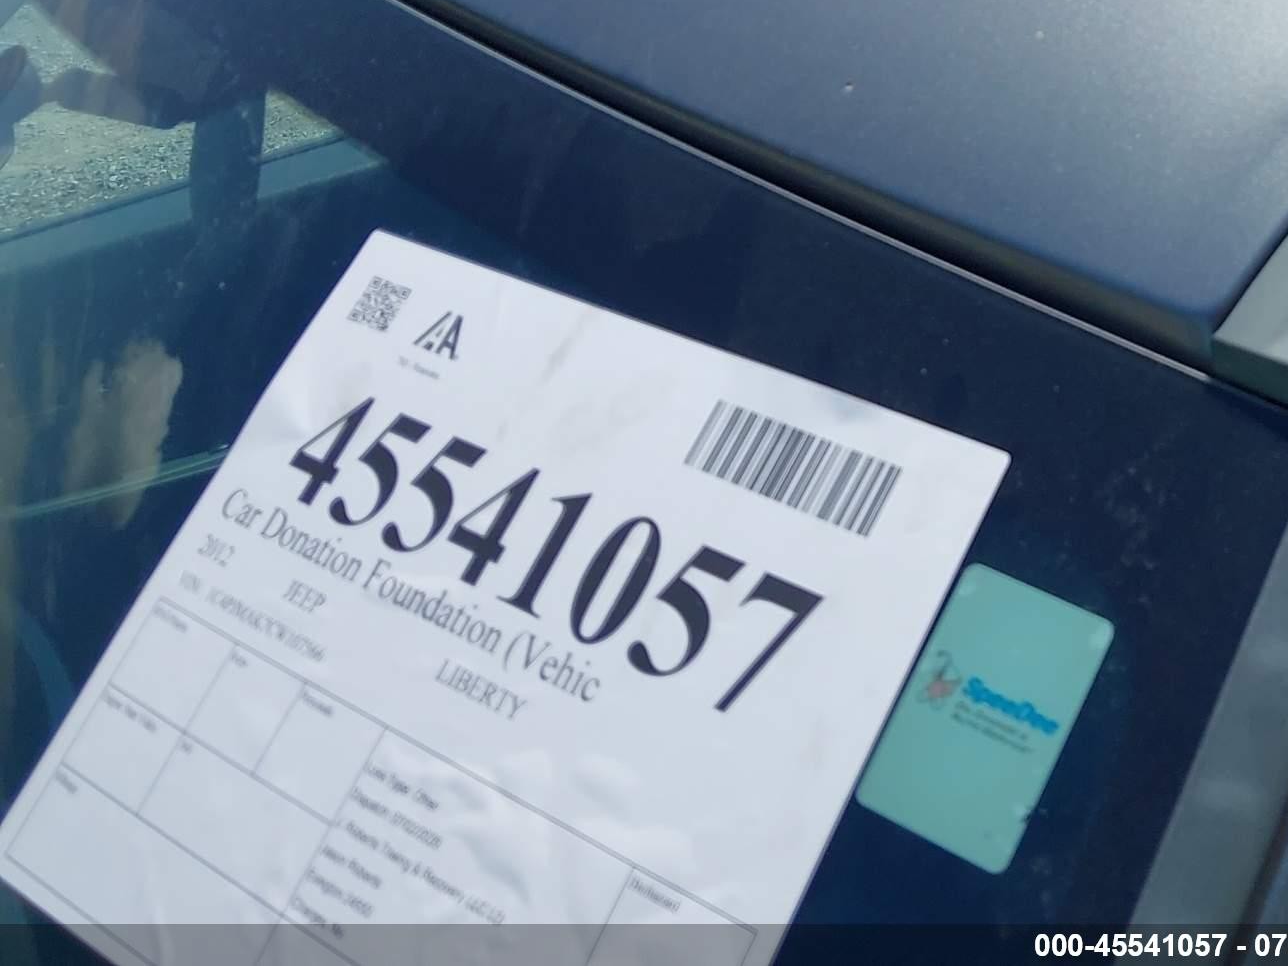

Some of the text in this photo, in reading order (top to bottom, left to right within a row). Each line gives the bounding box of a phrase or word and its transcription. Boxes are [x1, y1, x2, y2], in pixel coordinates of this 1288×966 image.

[220, 487, 601, 703] Car Donation Foundation (Vehic
[281, 578, 328, 614] JEEP
[434, 658, 528, 721] LIBERTY
[289, 396, 825, 713] 45541057
